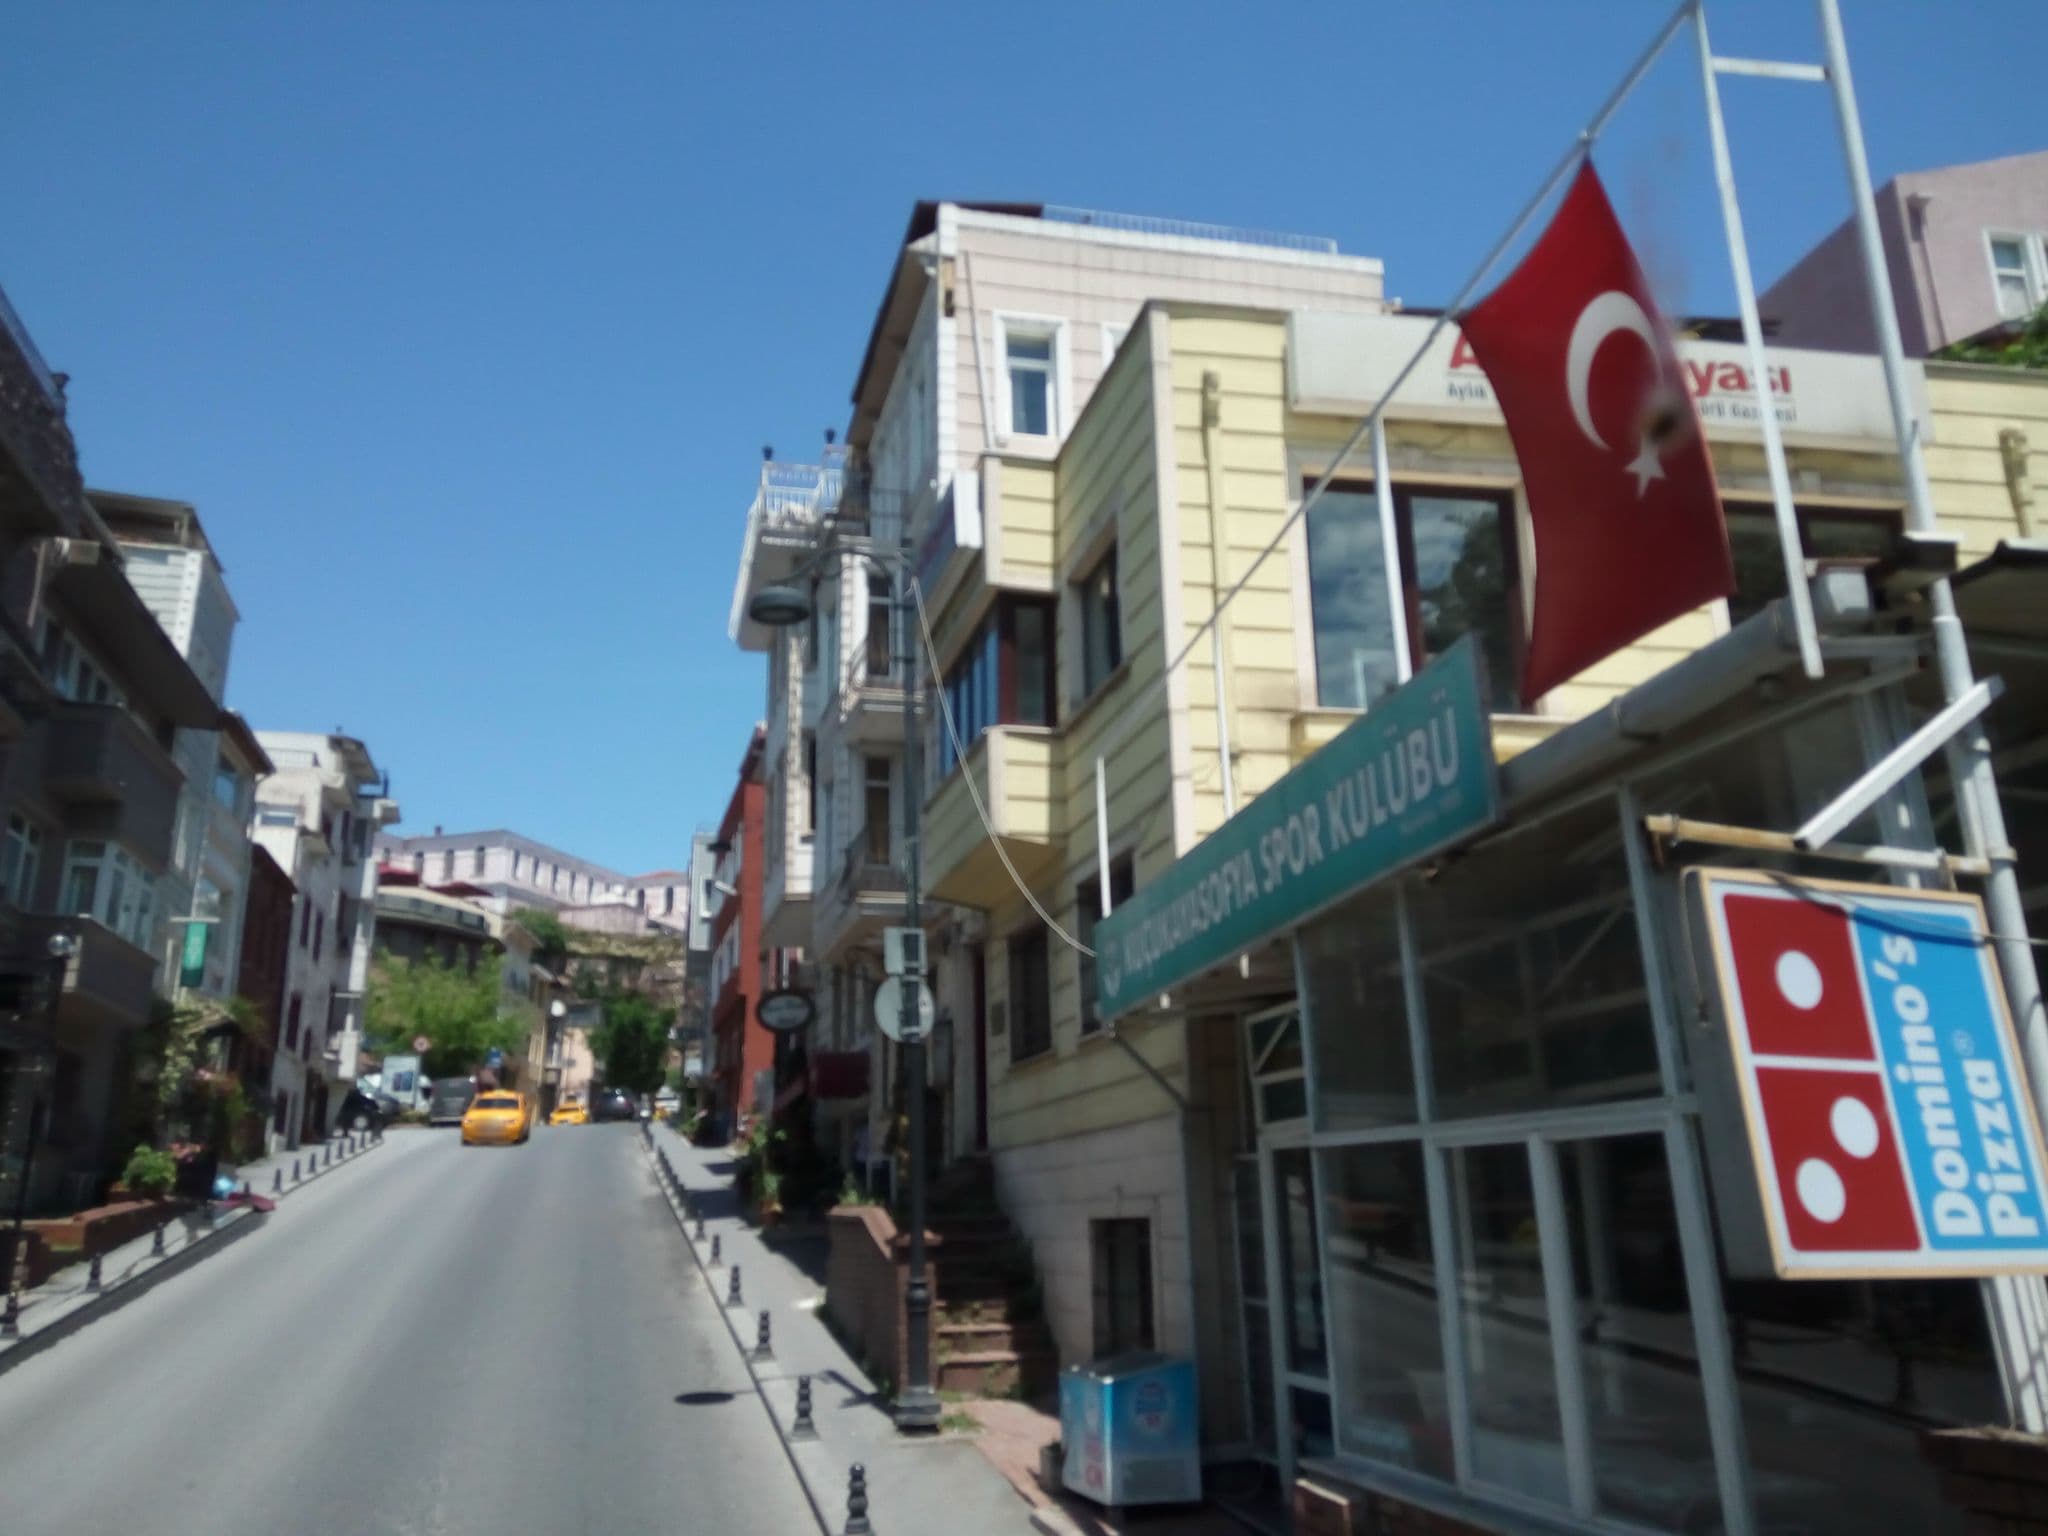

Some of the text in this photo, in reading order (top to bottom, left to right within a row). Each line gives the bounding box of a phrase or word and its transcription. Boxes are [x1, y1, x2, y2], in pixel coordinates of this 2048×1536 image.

[1258, 802, 1325, 895] SPOR
[1324, 688, 1461, 852] KULÜBÜ
[1872, 933, 1985, 1239] Domino's
[1960, 1058, 2040, 1238] Pizza
